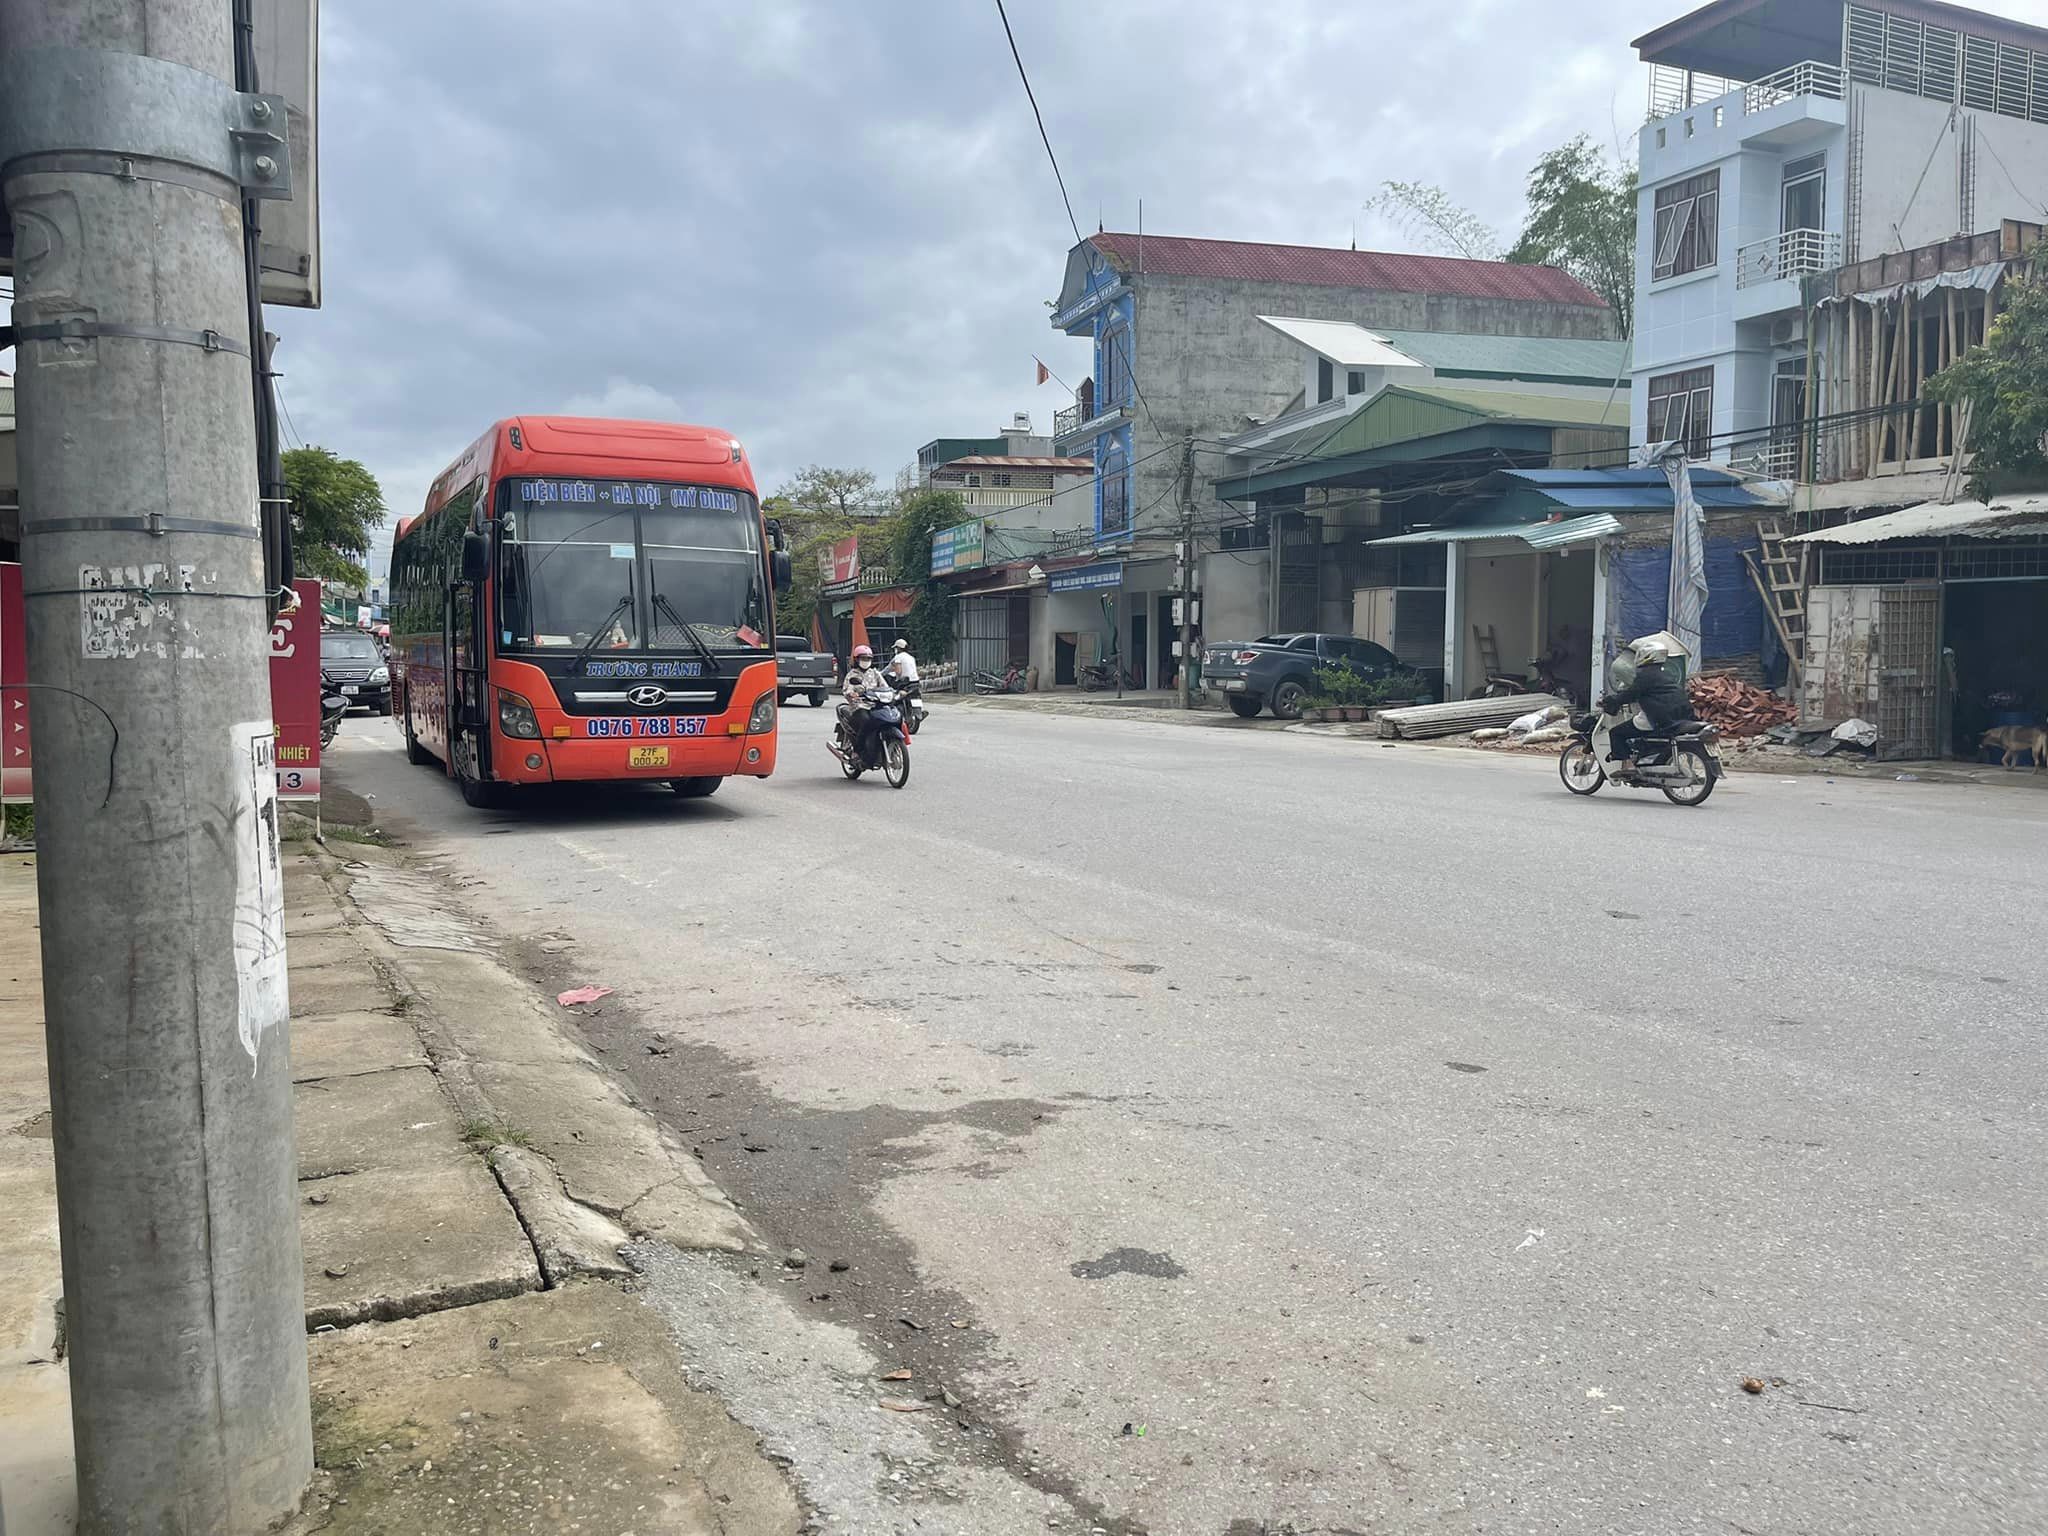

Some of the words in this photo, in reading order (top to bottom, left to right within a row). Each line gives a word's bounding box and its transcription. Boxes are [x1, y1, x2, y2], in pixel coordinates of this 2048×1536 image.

[521, 479, 557, 505] ĐIỆN
[560, 480, 596, 502] BIÊN
[612, 482, 633, 504] HÀ
[635, 484, 661, 509] NỘI
[587, 718, 633, 737] 0976
[638, 717, 670, 736] 788
[675, 717, 707, 736] 557
[279, 744, 311, 763] NHIỆT
[641, 748, 658, 757] 27F
